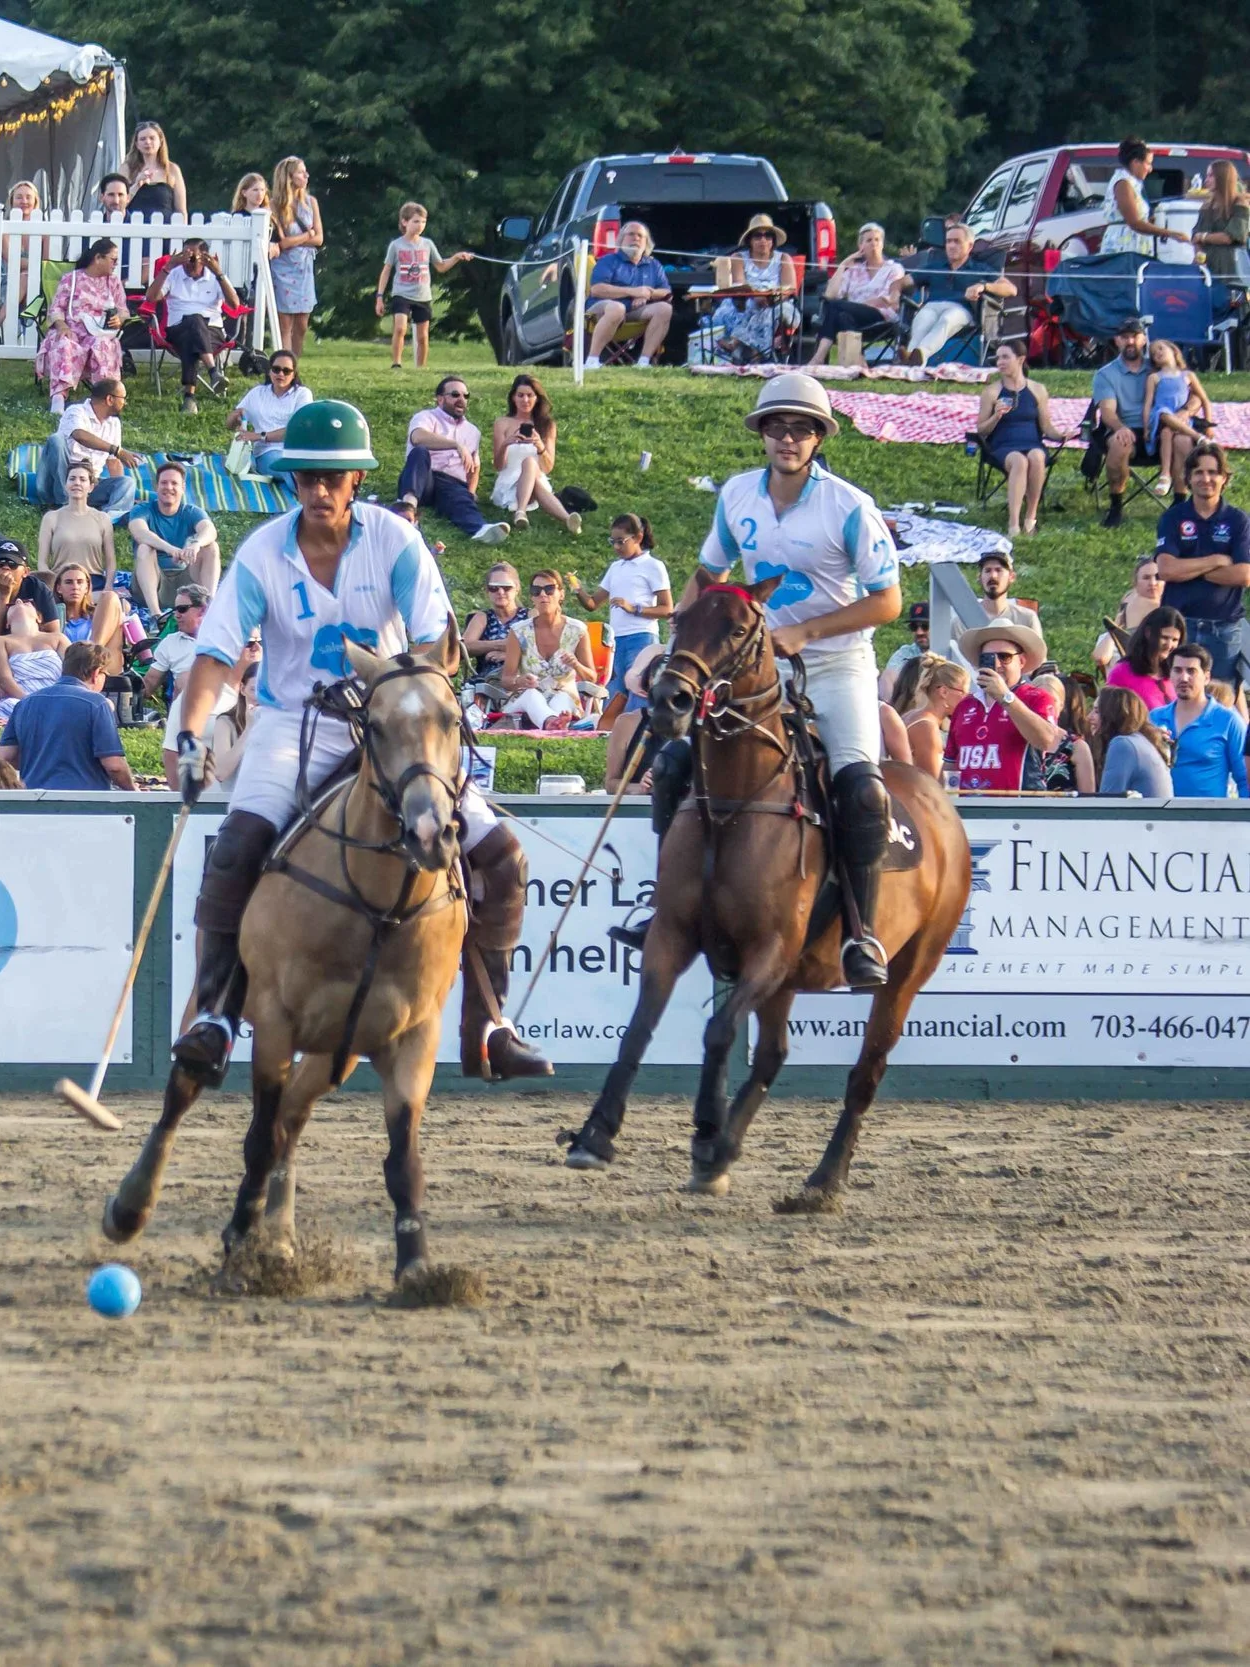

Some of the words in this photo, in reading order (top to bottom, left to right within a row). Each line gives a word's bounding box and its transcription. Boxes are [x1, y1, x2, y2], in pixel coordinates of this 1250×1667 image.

[740, 517, 758, 551] 2
[872, 538, 895, 575] 2
[291, 580, 316, 621] 1
[958, 744, 1002, 770] USA
[1008, 839, 1250, 893] FINANCIA
[525, 878, 597, 907] ner
[611, 867, 658, 907] La
[988, 914, 1250, 940] MANAGEMENT
[549, 931, 643, 986] help
[945, 962, 1067, 975] AGEMENT
[1082, 962, 1153, 976] MADE
[1168, 962, 1244, 976] SIMPL
[516, 1017, 629, 1041] nerlaw.co
[786, 1013, 1067, 1039] ww.annancial.com
[1090, 1014, 1250, 1040] 703-466-047
